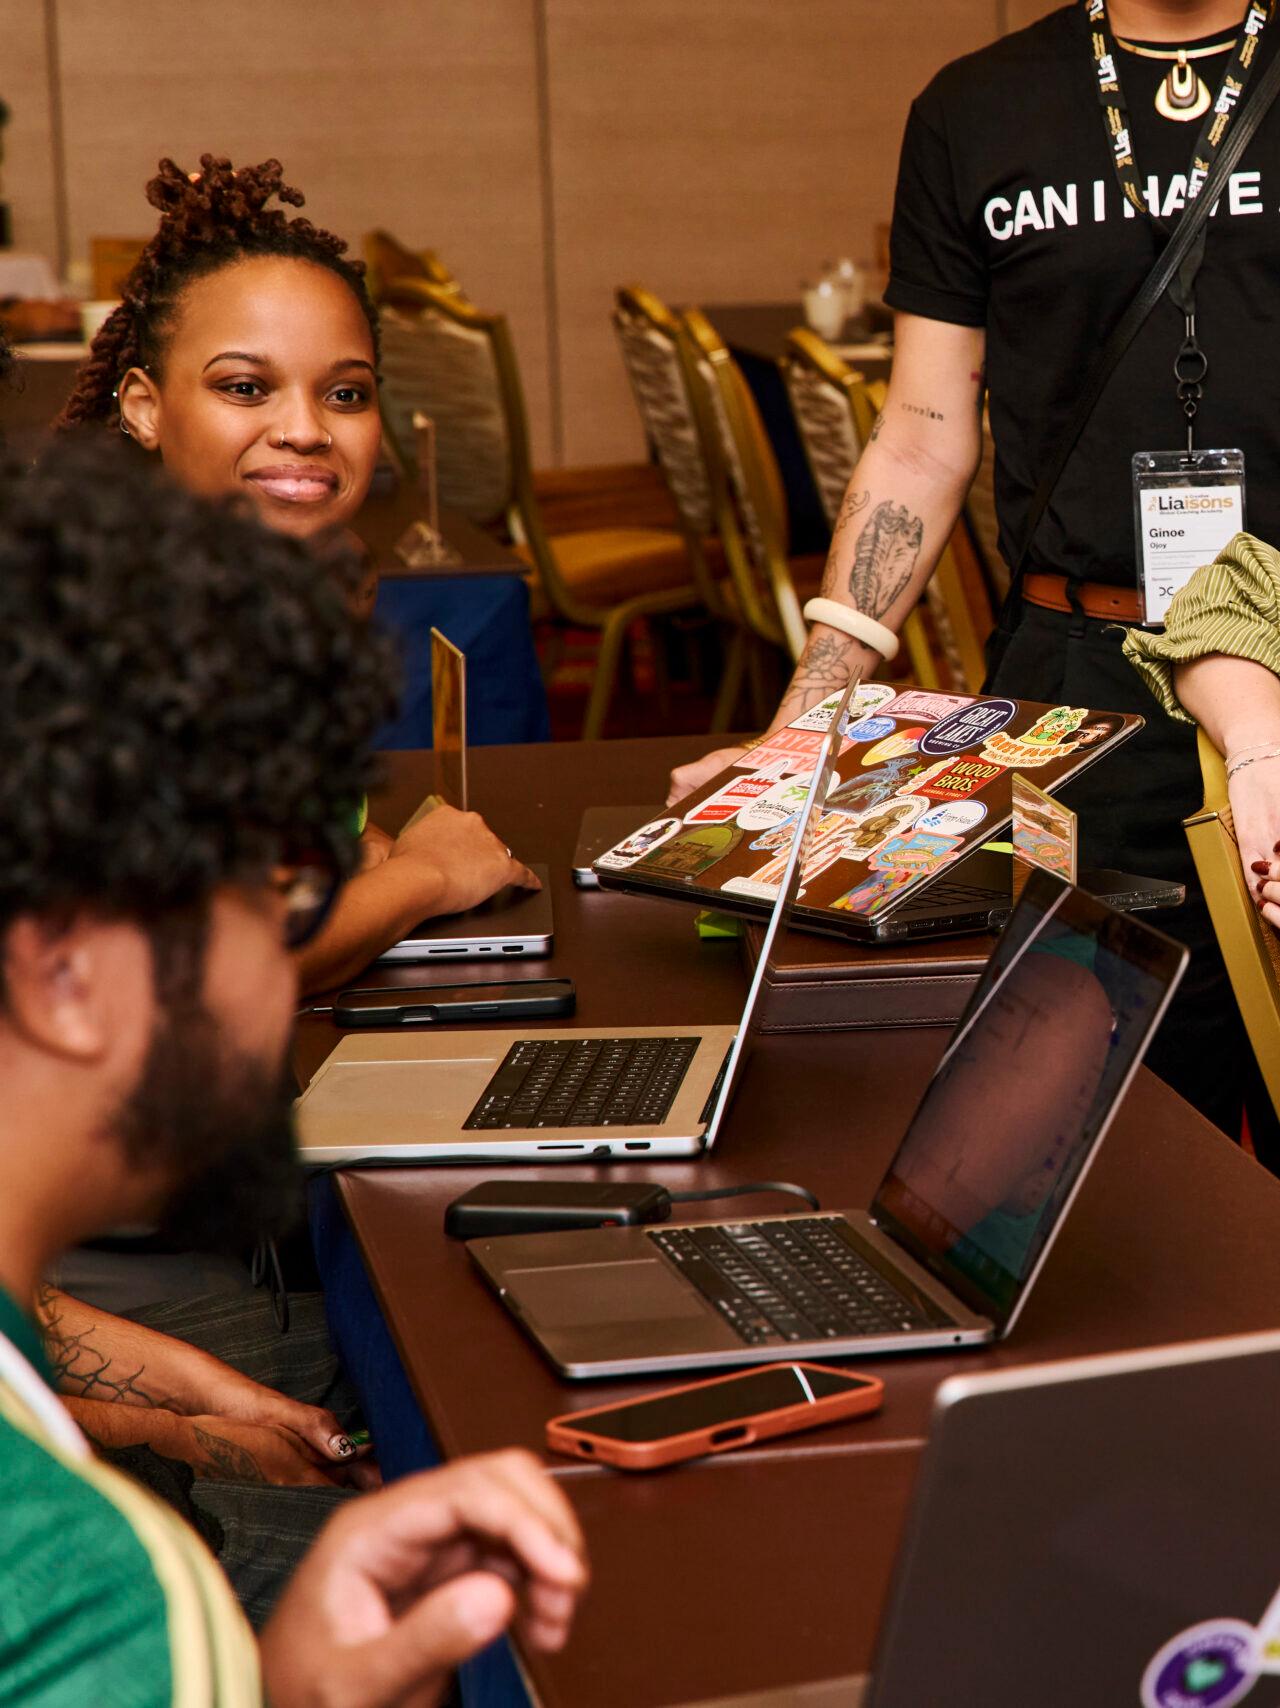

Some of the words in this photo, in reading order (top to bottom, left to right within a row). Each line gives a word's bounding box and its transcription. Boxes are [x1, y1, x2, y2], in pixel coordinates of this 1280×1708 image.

[1244, 8, 1267, 36] Lia
[1099, 55, 1117, 84] Lia
[1214, 85, 1240, 114] Lia
[1114, 128, 1131, 160] Lia
[984, 184, 1078, 240] CAN
[1093, 180, 1105, 222] I
[1123, 172, 1263, 218] HAE
[1158, 496, 1233, 511] Liaisons
[1149, 528, 1185, 538] Ginoe
[959, 706, 1009, 728] GREAT
[936, 722, 984, 743] LAKES
[950, 761, 1000, 779] WOOD
[933, 774, 979, 792] BROS.
